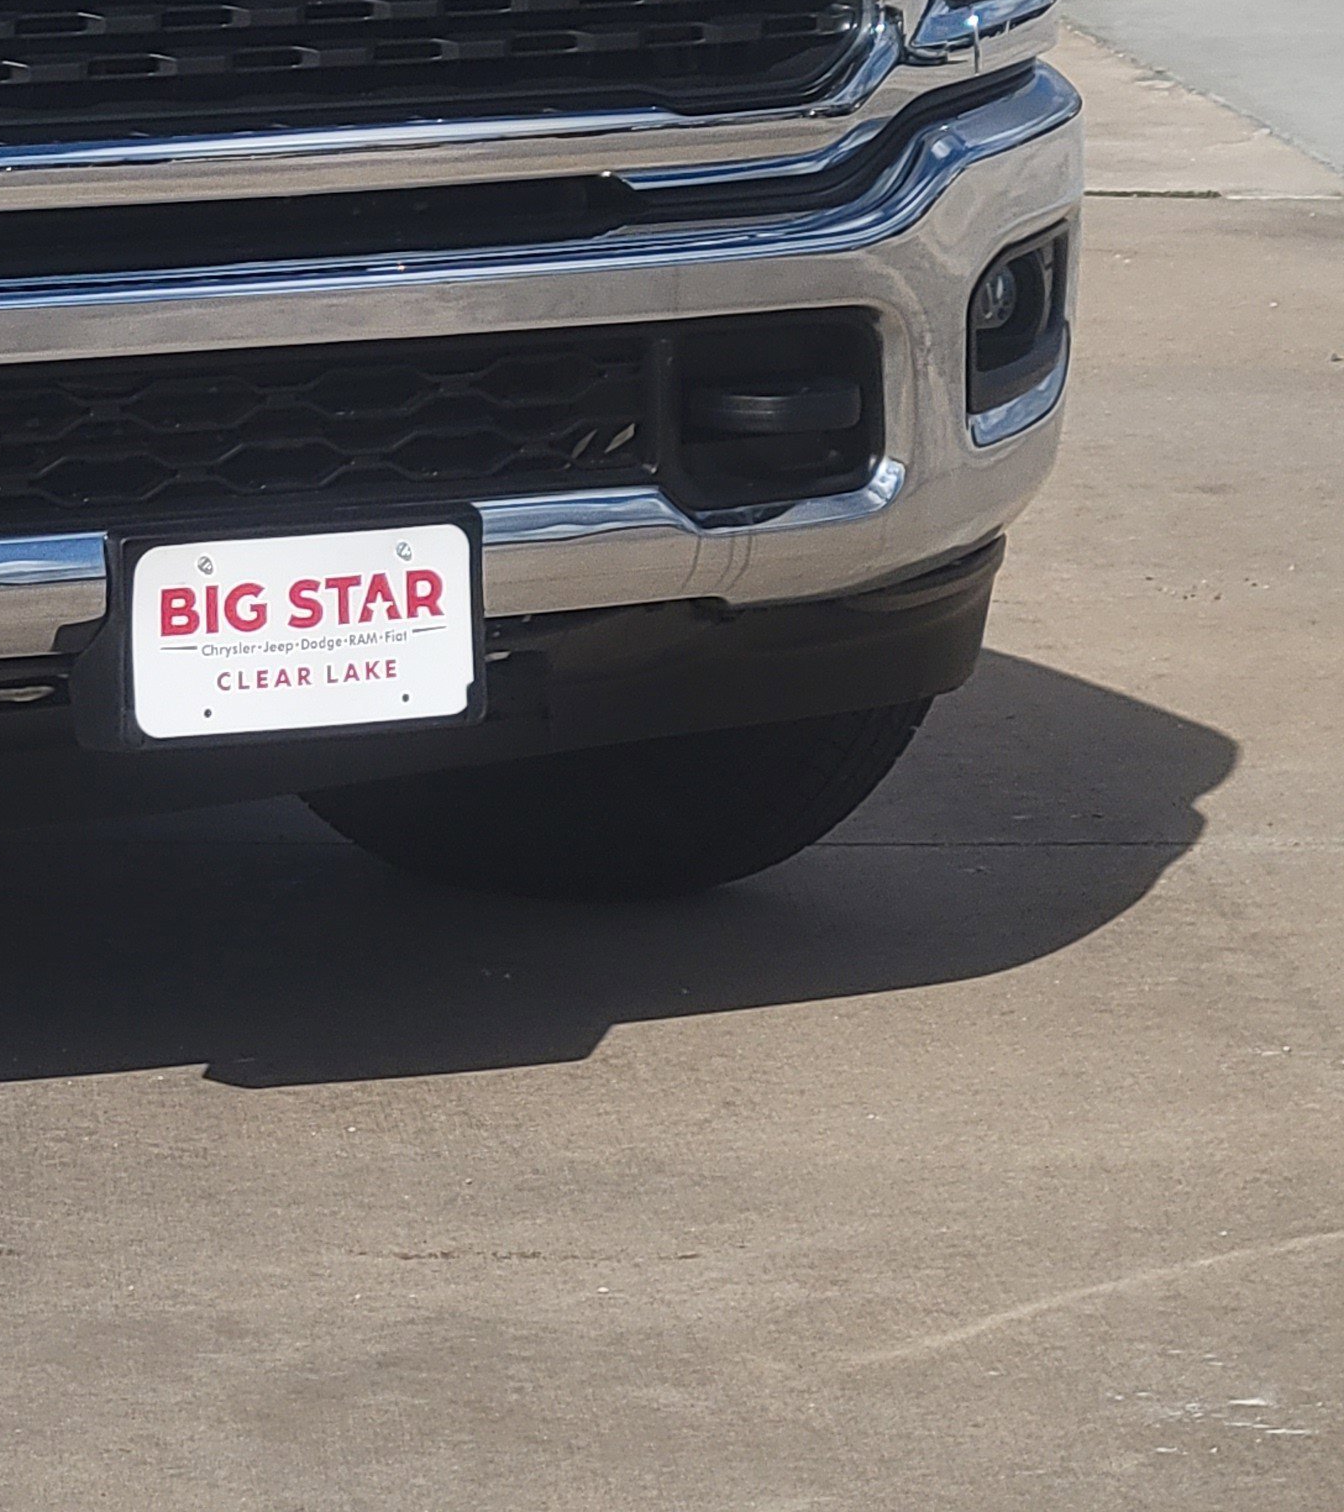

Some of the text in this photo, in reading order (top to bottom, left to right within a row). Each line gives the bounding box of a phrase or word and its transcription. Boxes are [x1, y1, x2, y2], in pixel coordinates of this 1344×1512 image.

[160, 569, 445, 637] BIG STAR
[216, 659, 398, 691] CLEAR LAKE
